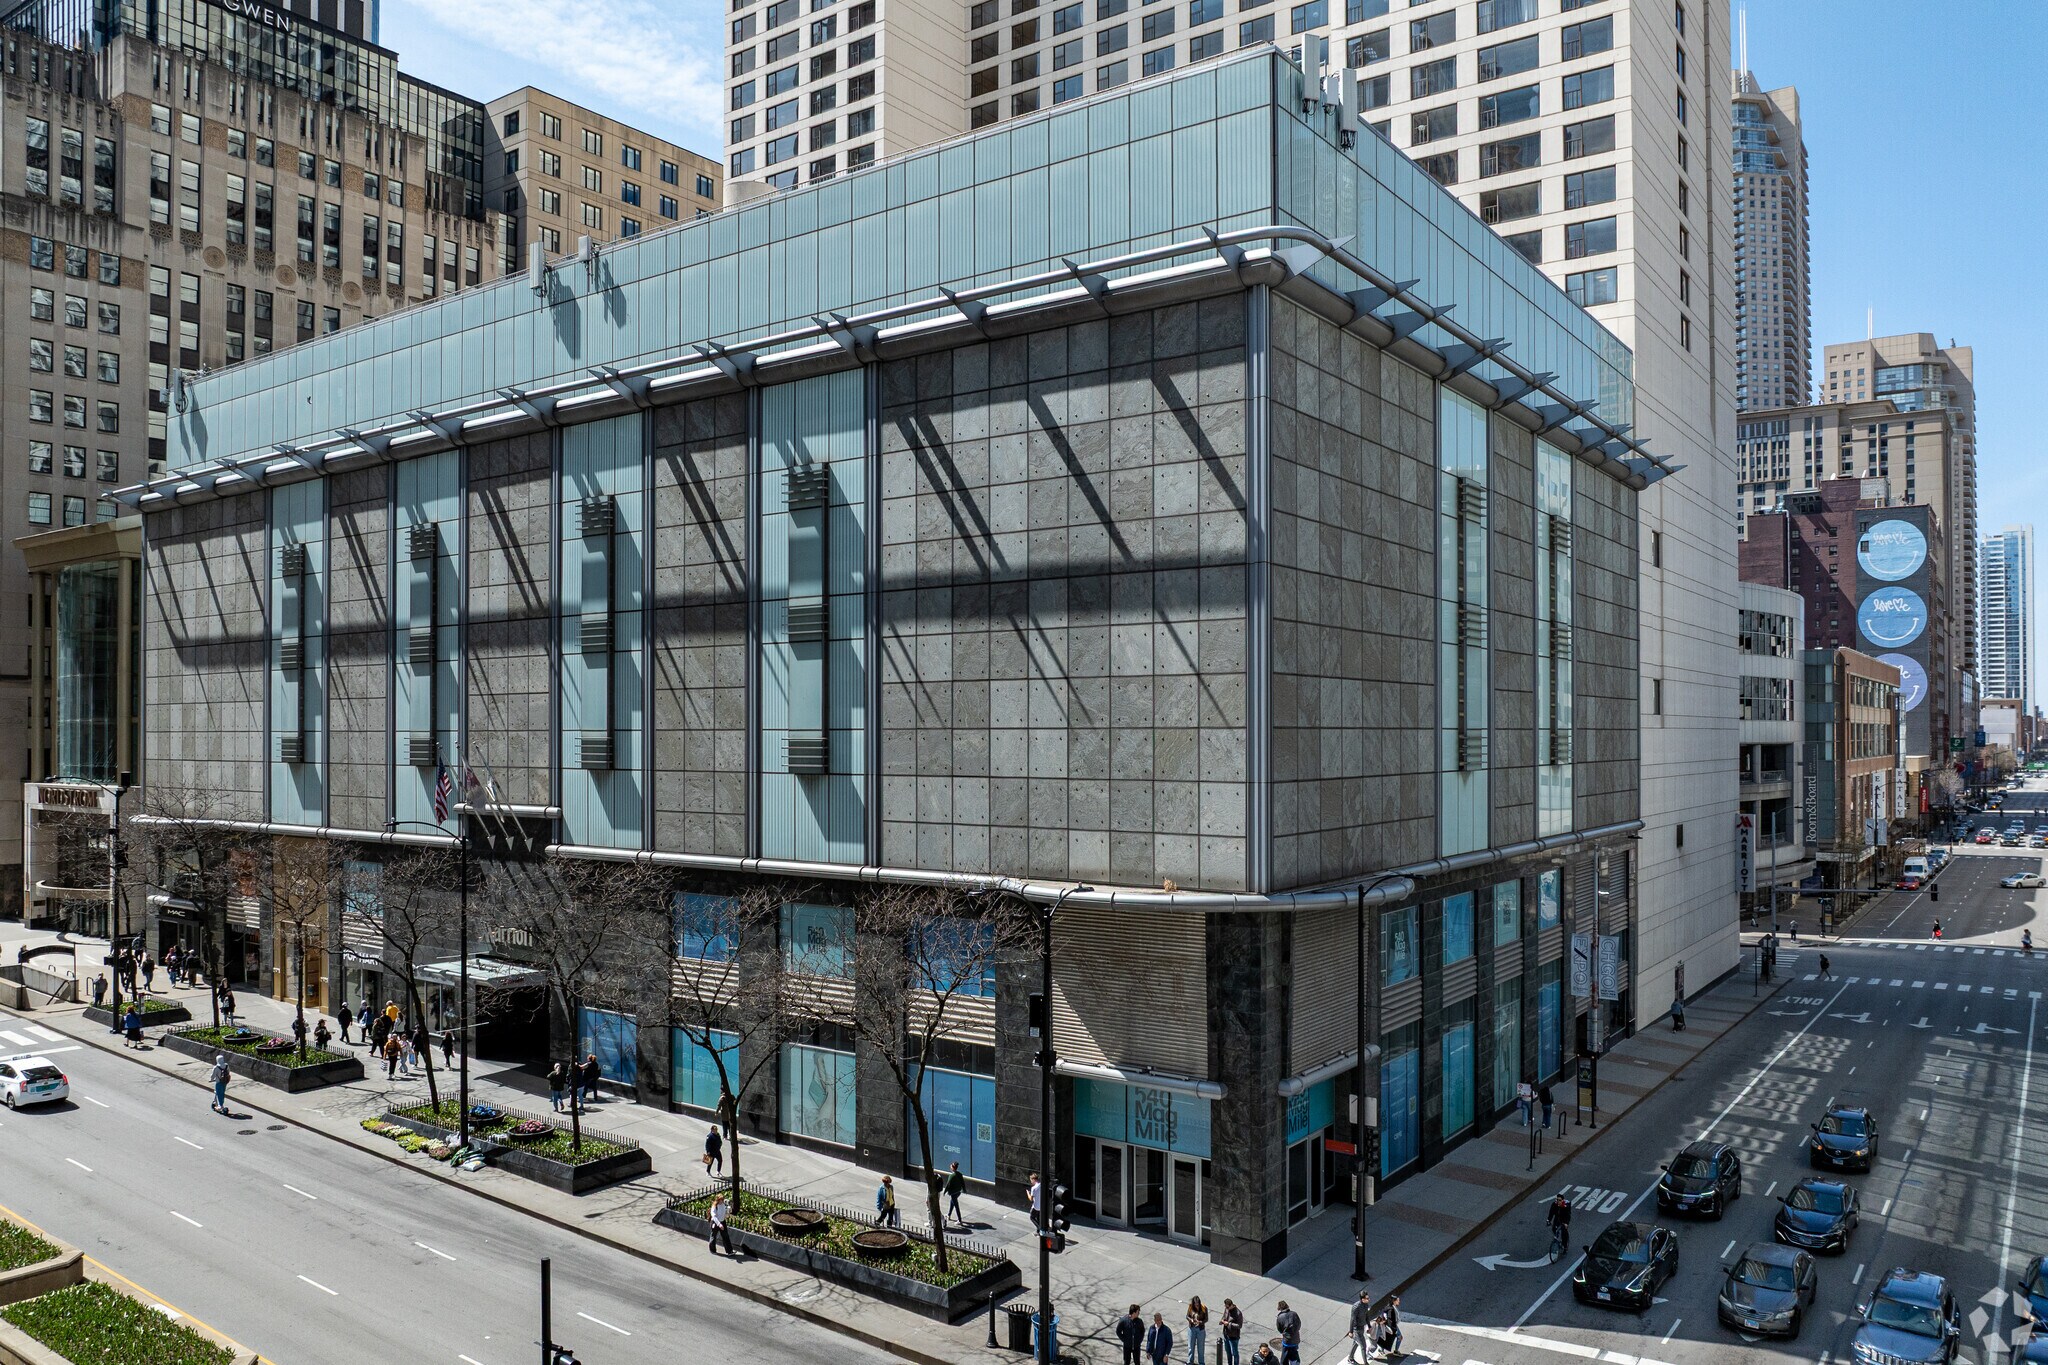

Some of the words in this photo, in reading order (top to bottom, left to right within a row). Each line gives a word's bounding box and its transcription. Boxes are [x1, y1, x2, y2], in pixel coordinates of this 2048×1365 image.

[224, 0, 289, 32] GWEN
[38, 787, 98, 807] NORDSTROM
[1740, 828, 1749, 892] MARRIOTT
[167, 909, 186, 917] MAC
[1573, 935, 1589, 986] EXPO
[1601, 938, 1617, 989] CHGO
[1135, 1086, 1173, 1107] 540
[1135, 1100, 1178, 1129] Mag
[1288, 1114, 1308, 1135] Mile
[1135, 1120, 1178, 1145] Mile
[943, 1144, 960, 1154] CBRE
